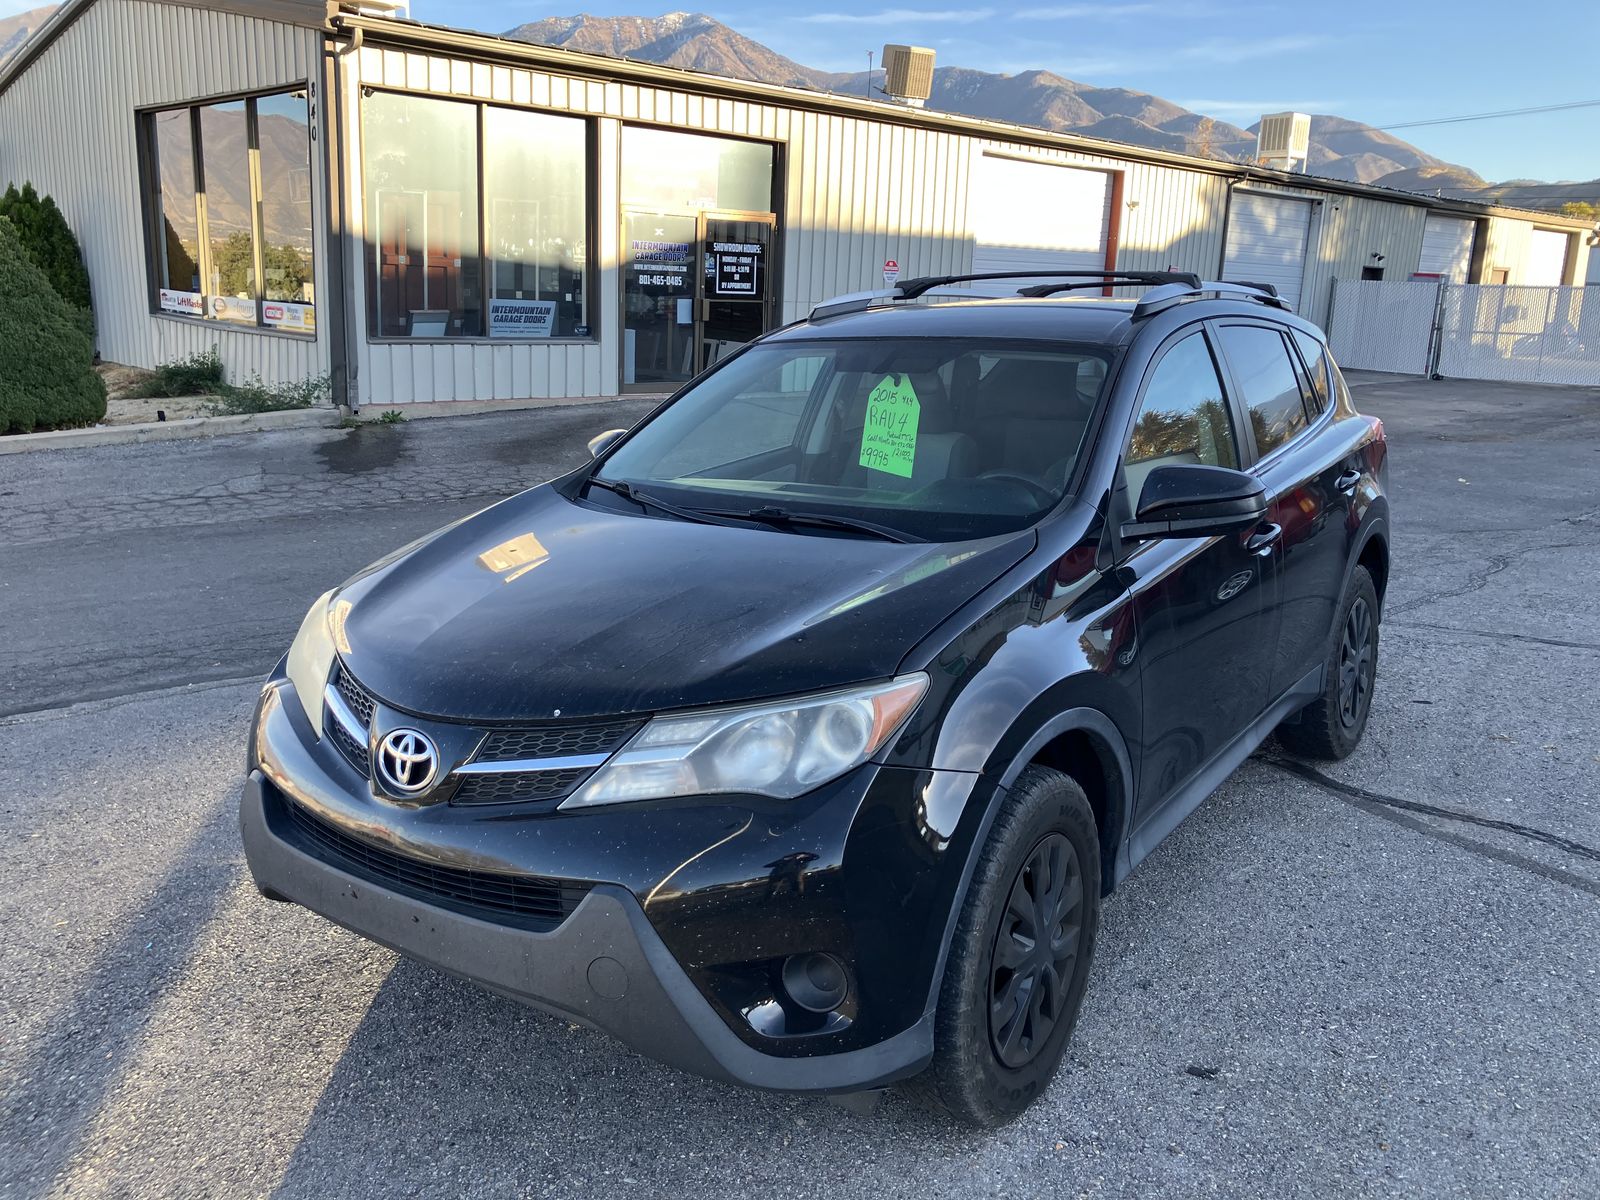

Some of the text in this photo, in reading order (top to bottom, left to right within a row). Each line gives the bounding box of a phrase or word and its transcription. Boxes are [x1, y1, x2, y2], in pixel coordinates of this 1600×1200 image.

[632, 240, 689, 253] INTERMOUNTAIN
[714, 243, 761, 253] SHOWROOM HOURS:
[635, 252, 686, 262] GARAGE DOORS
[639, 274, 682, 286] 801-465-0485
[491, 305, 551, 315] INTERMOUNTAIN
[493, 315, 547, 324] GARAGE DOORS
[874, 388, 898, 404] 2015
[870, 405, 896, 430] RAV
